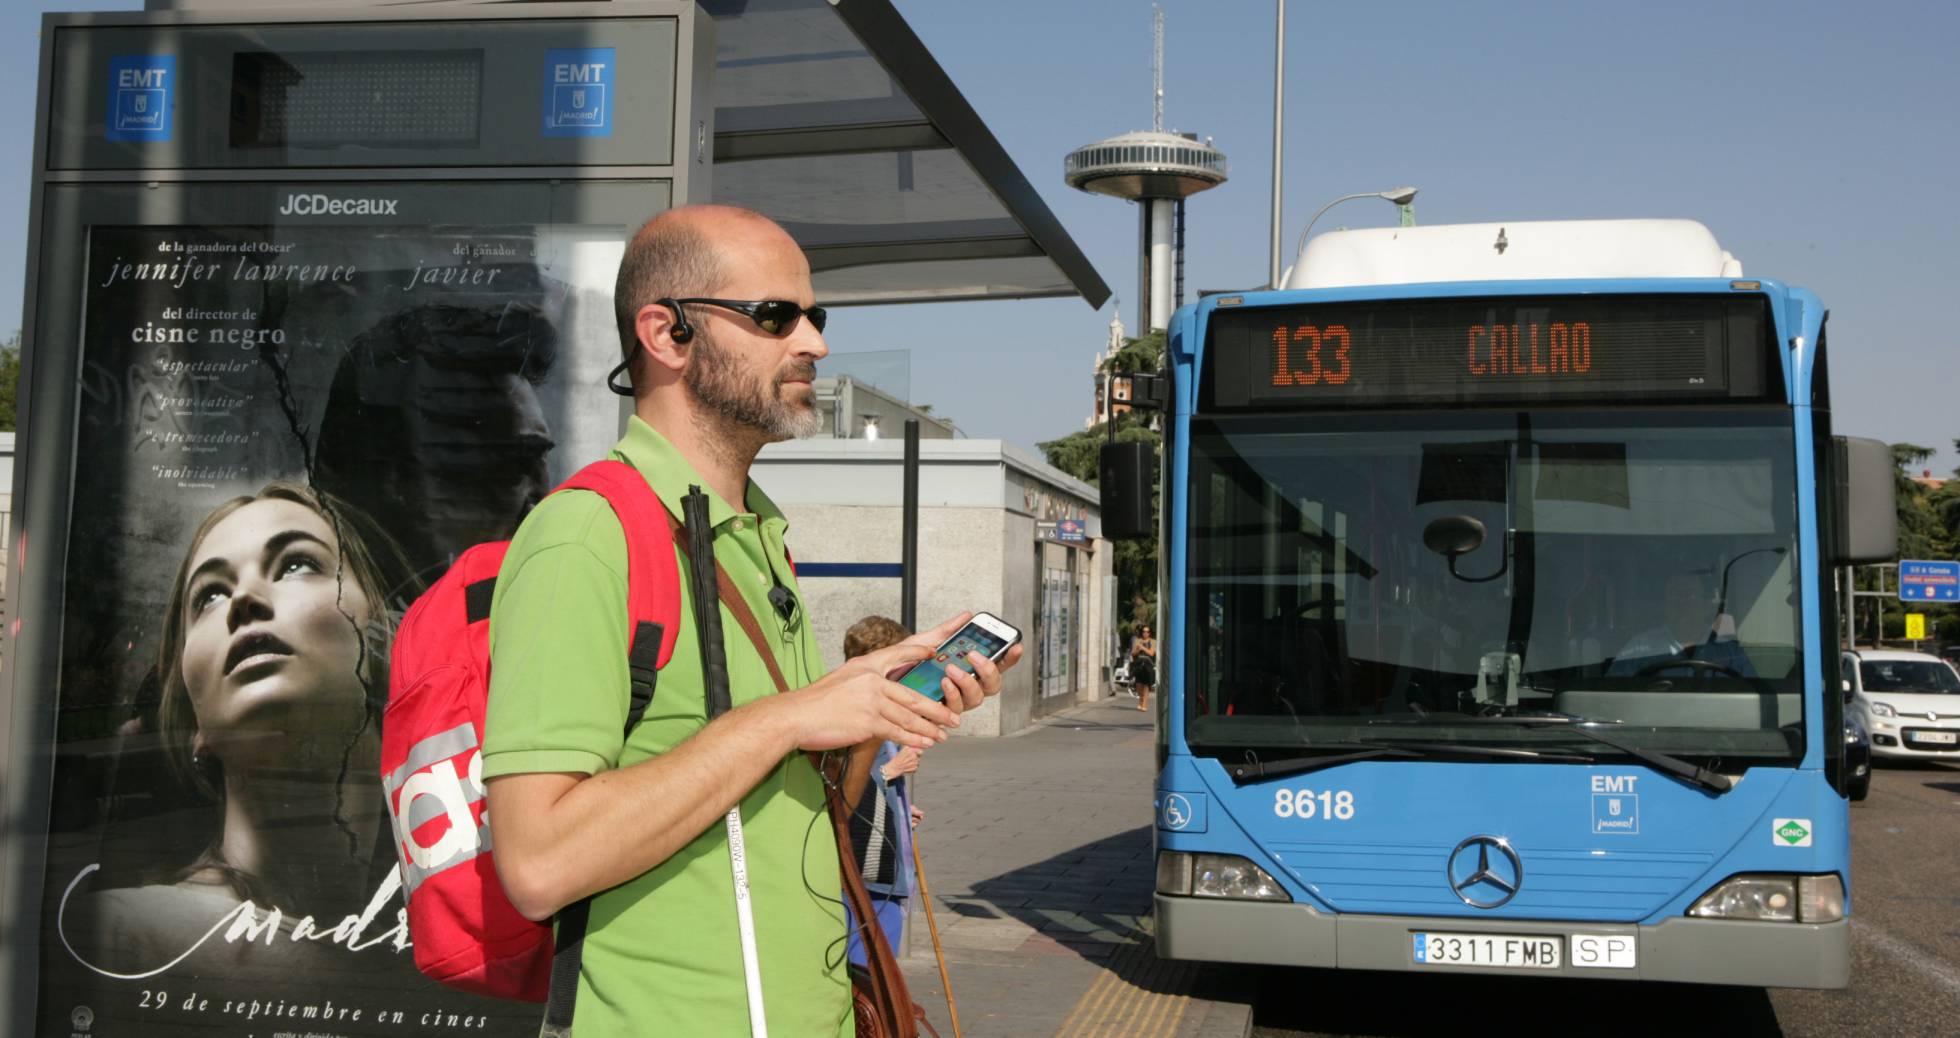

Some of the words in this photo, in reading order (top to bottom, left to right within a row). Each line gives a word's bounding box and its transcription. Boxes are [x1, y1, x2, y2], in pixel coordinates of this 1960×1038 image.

[119, 69, 167, 88] EMT
[554, 63, 606, 83] EMT
[279, 194, 398, 217] JCDecaux
[158, 241, 172, 252] de
[173, 241, 184, 252] la
[186, 242, 237, 254] ganadora
[239, 242, 256, 252] del
[102, 256, 221, 289] jennifer
[233, 256, 356, 281] lawrence
[403, 259, 502, 291] javier
[162, 307, 183, 320] del
[186, 308, 238, 321] director
[241, 308, 257, 320] de
[131, 321, 199, 343] cisne
[208, 327, 286, 350] negro
[1271, 324, 1352, 386] 133
[1467, 321, 1592, 376] CALLAO
[1591, 775, 1638, 793] EMT
[1274, 788, 1355, 820] 8618
[1781, 828, 1804, 838] GNC
[1431, 937, 1494, 963] 3311
[1504, 940, 1555, 965] FMB
[139, 990, 168, 1009] 29
[182, 993, 208, 1011] de
[223, 998, 362, 1021] septiembre
[378, 1009, 403, 1024] en
[421, 1010, 487, 1028] cines
